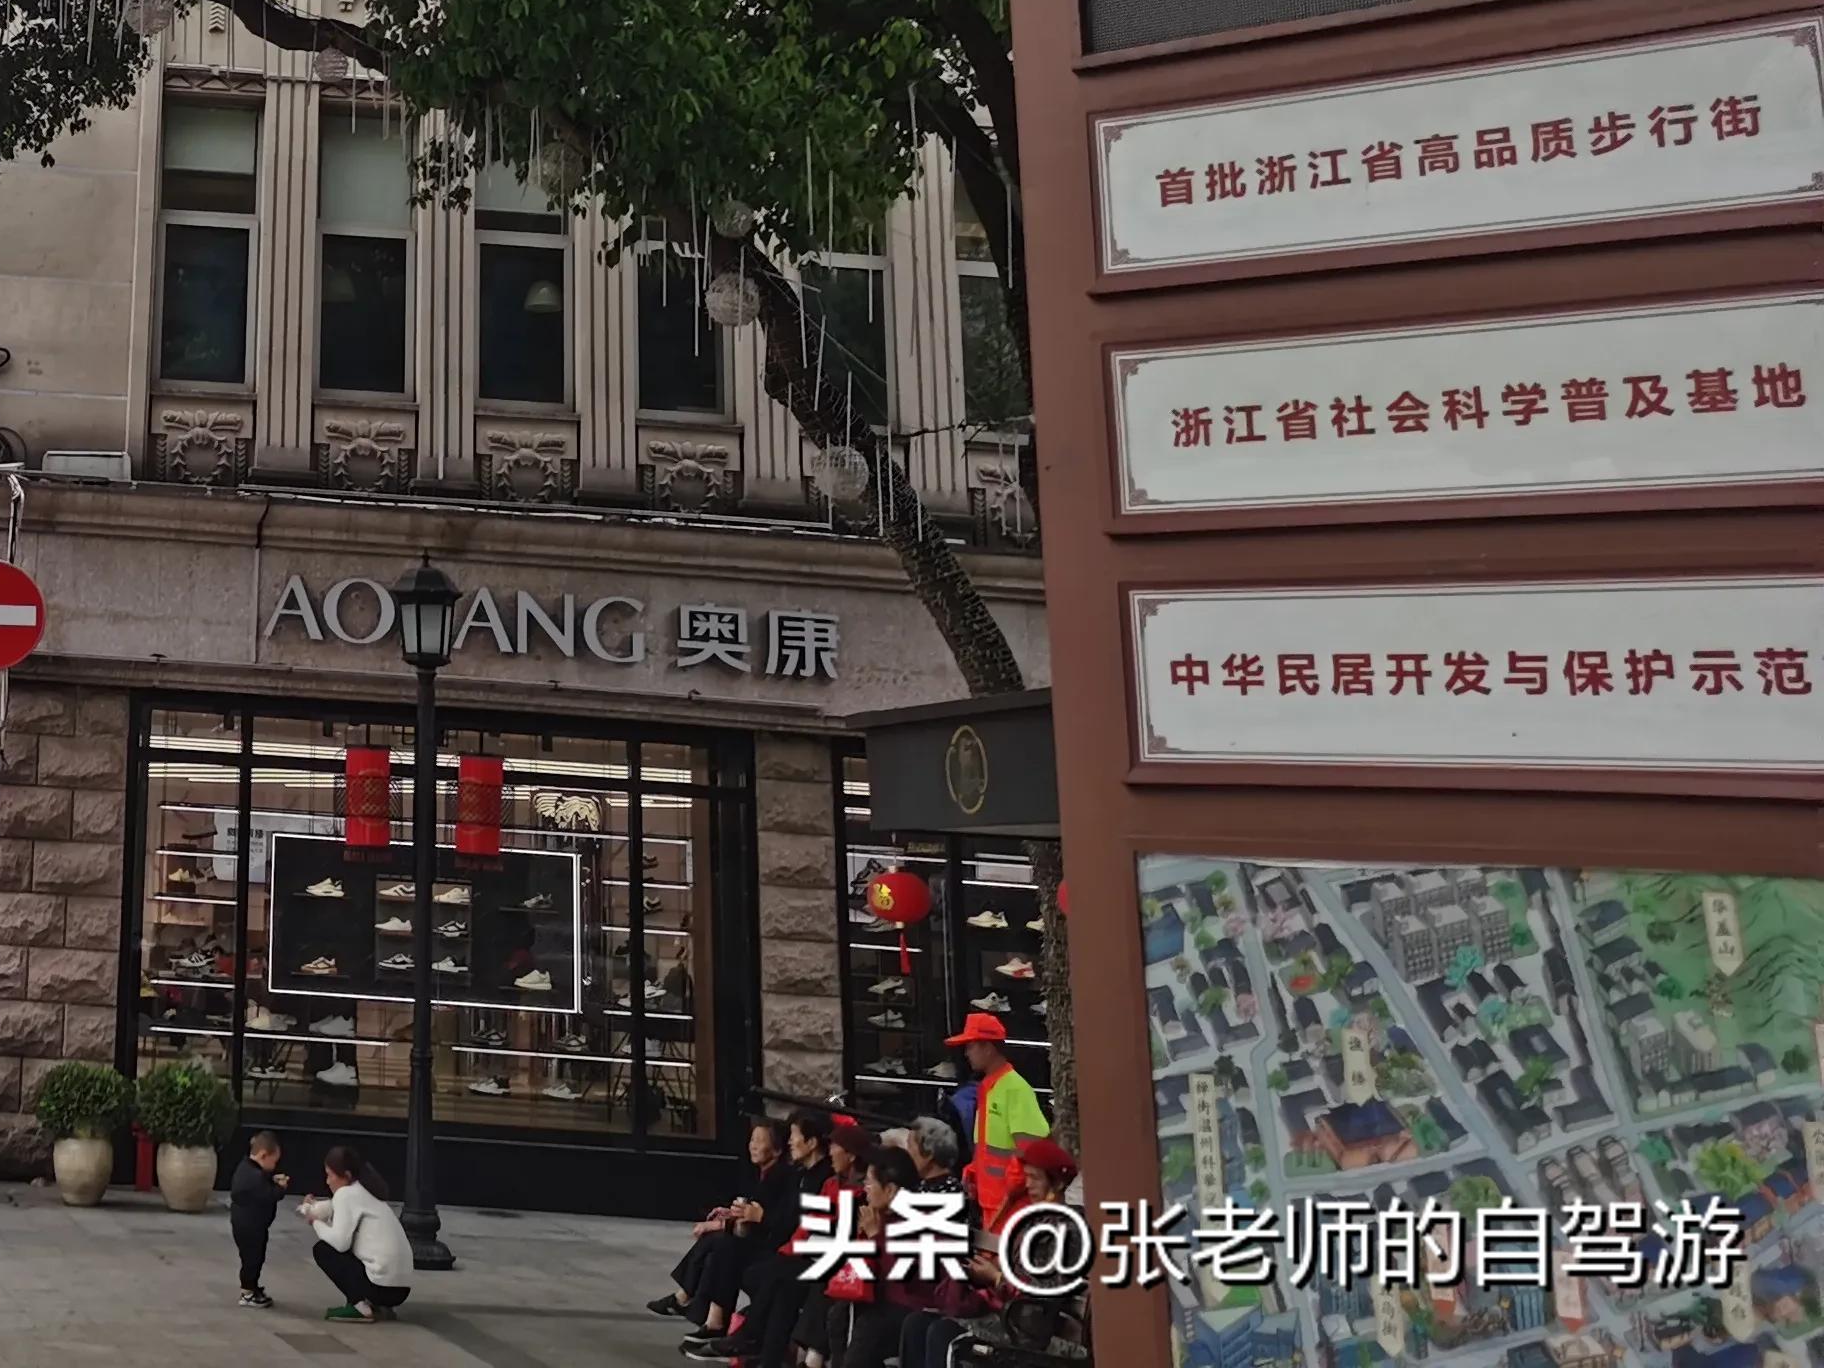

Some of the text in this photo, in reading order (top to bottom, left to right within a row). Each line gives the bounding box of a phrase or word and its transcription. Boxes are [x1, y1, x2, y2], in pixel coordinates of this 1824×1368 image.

[1155, 94, 1764, 209] 首批浙江省高品质步行街
[1169, 363, 1808, 448] 浙江省社会科学普及基地
[264, 574, 841, 680] AOANG 奥康
[1169, 646, 1813, 697] 中华民居开发与保护示范
